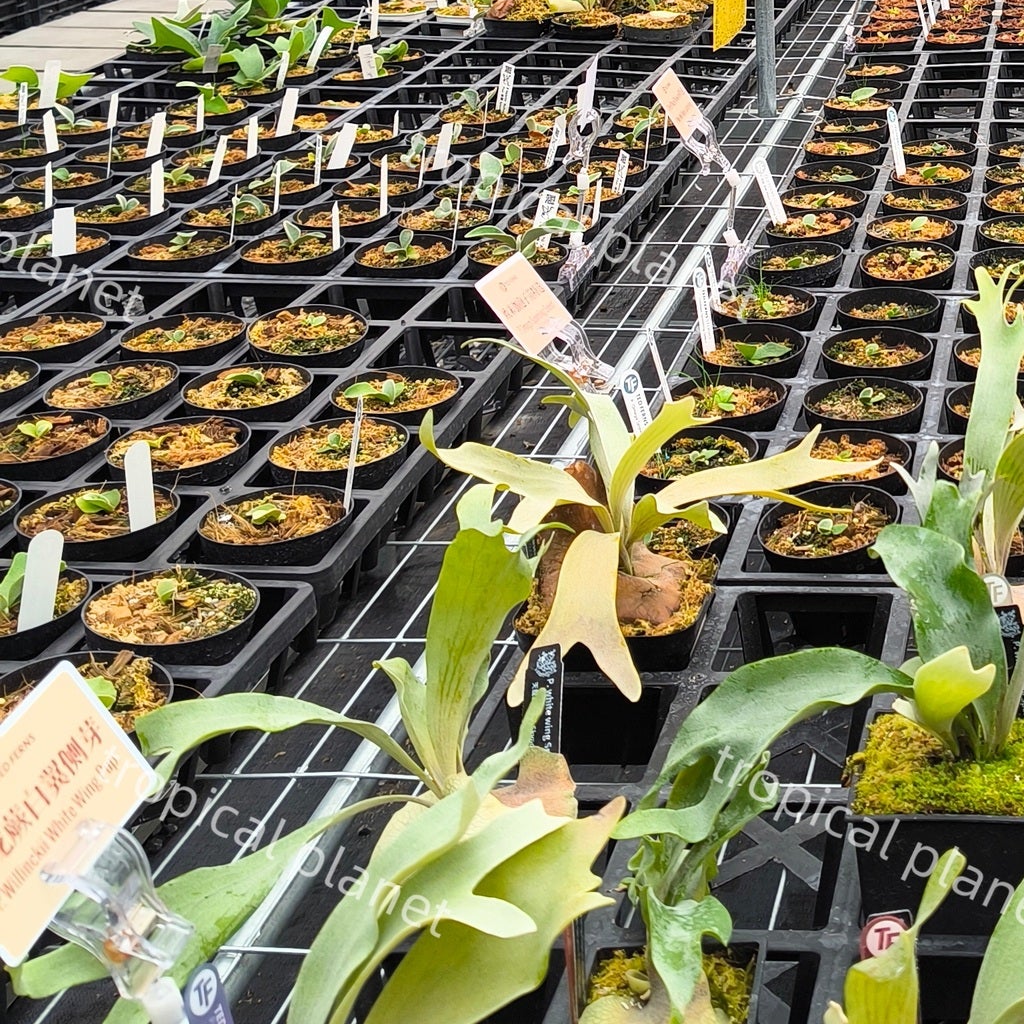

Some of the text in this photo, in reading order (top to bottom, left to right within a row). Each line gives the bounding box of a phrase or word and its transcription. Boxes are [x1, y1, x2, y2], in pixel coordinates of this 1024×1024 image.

[44, 807, 80, 843] White
[72, 776, 104, 808] Wing
[194, 978, 213, 1006] TF
